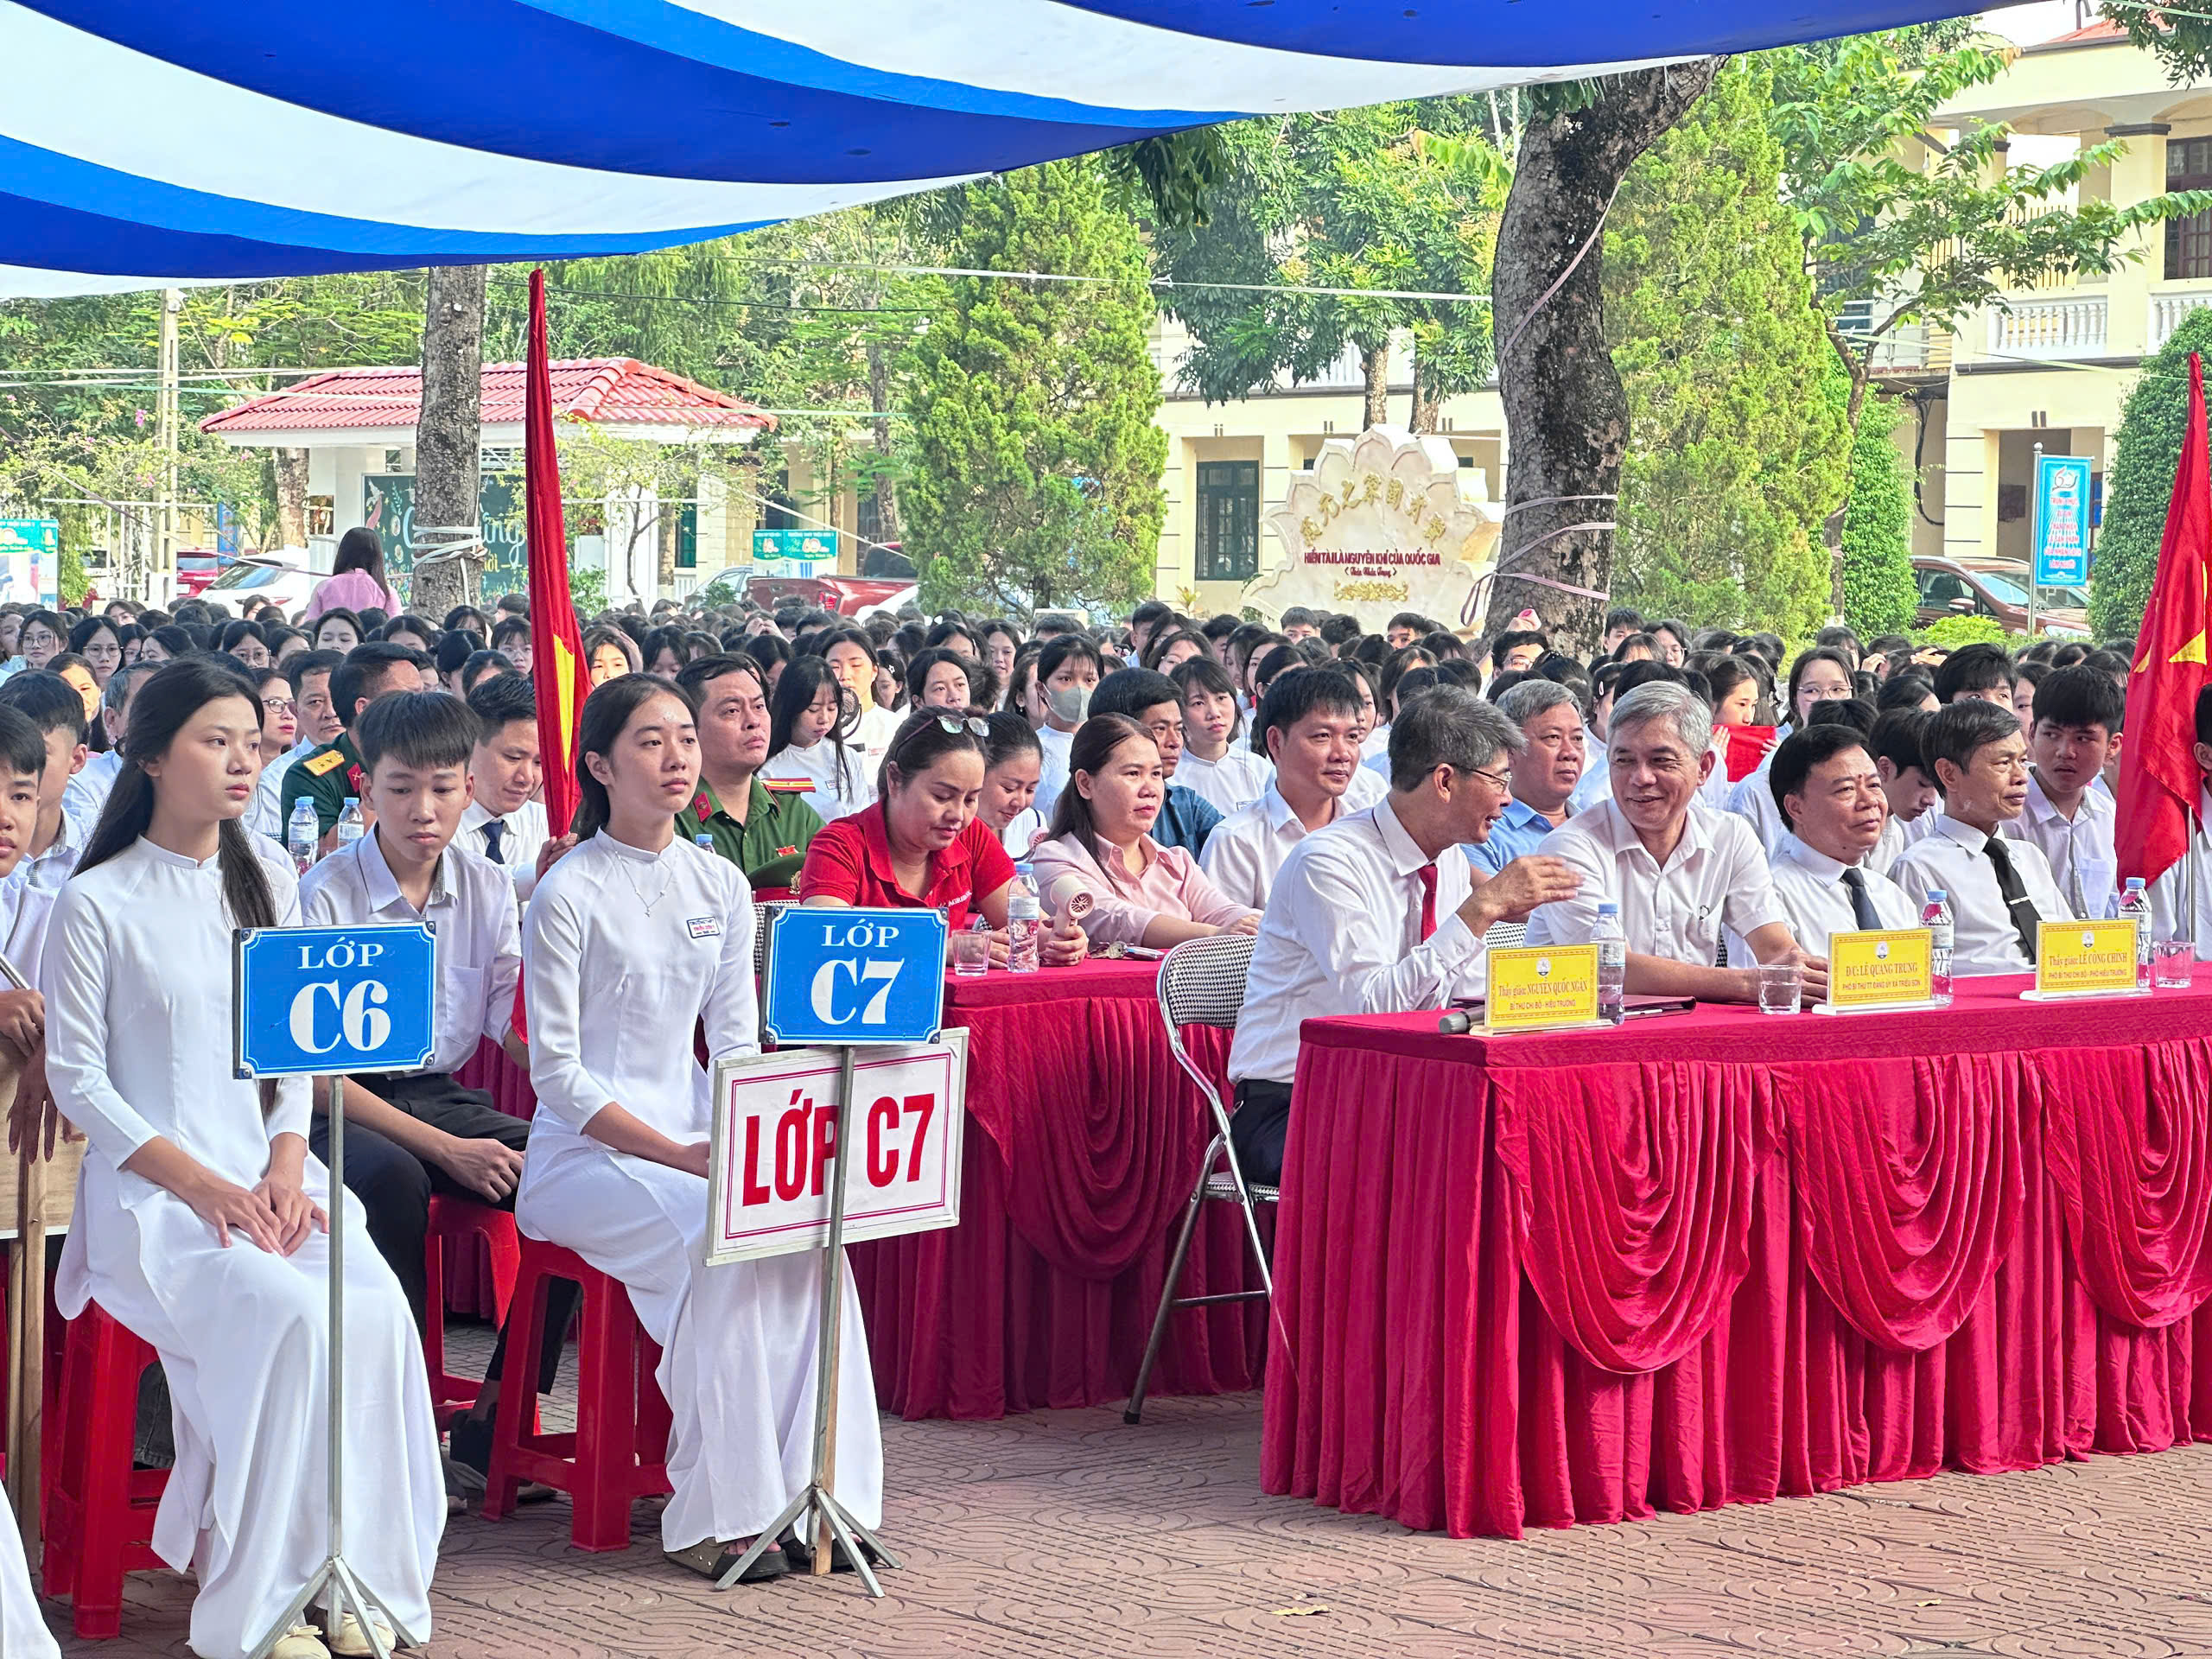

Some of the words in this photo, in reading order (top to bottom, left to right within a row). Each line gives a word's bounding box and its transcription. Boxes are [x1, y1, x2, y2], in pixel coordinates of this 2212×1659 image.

[821, 918, 899, 948] LỚP
[297, 936, 384, 969] LỚP
[1553, 977, 1570, 995] QUỐC
[1870, 963, 1893, 977] QUANG
[1894, 962, 1918, 974] TRUNG
[810, 957, 905, 1025] C7
[289, 979, 391, 1054] C6
[742, 1089, 841, 1206] LỚP
[867, 1093, 935, 1188] C7
